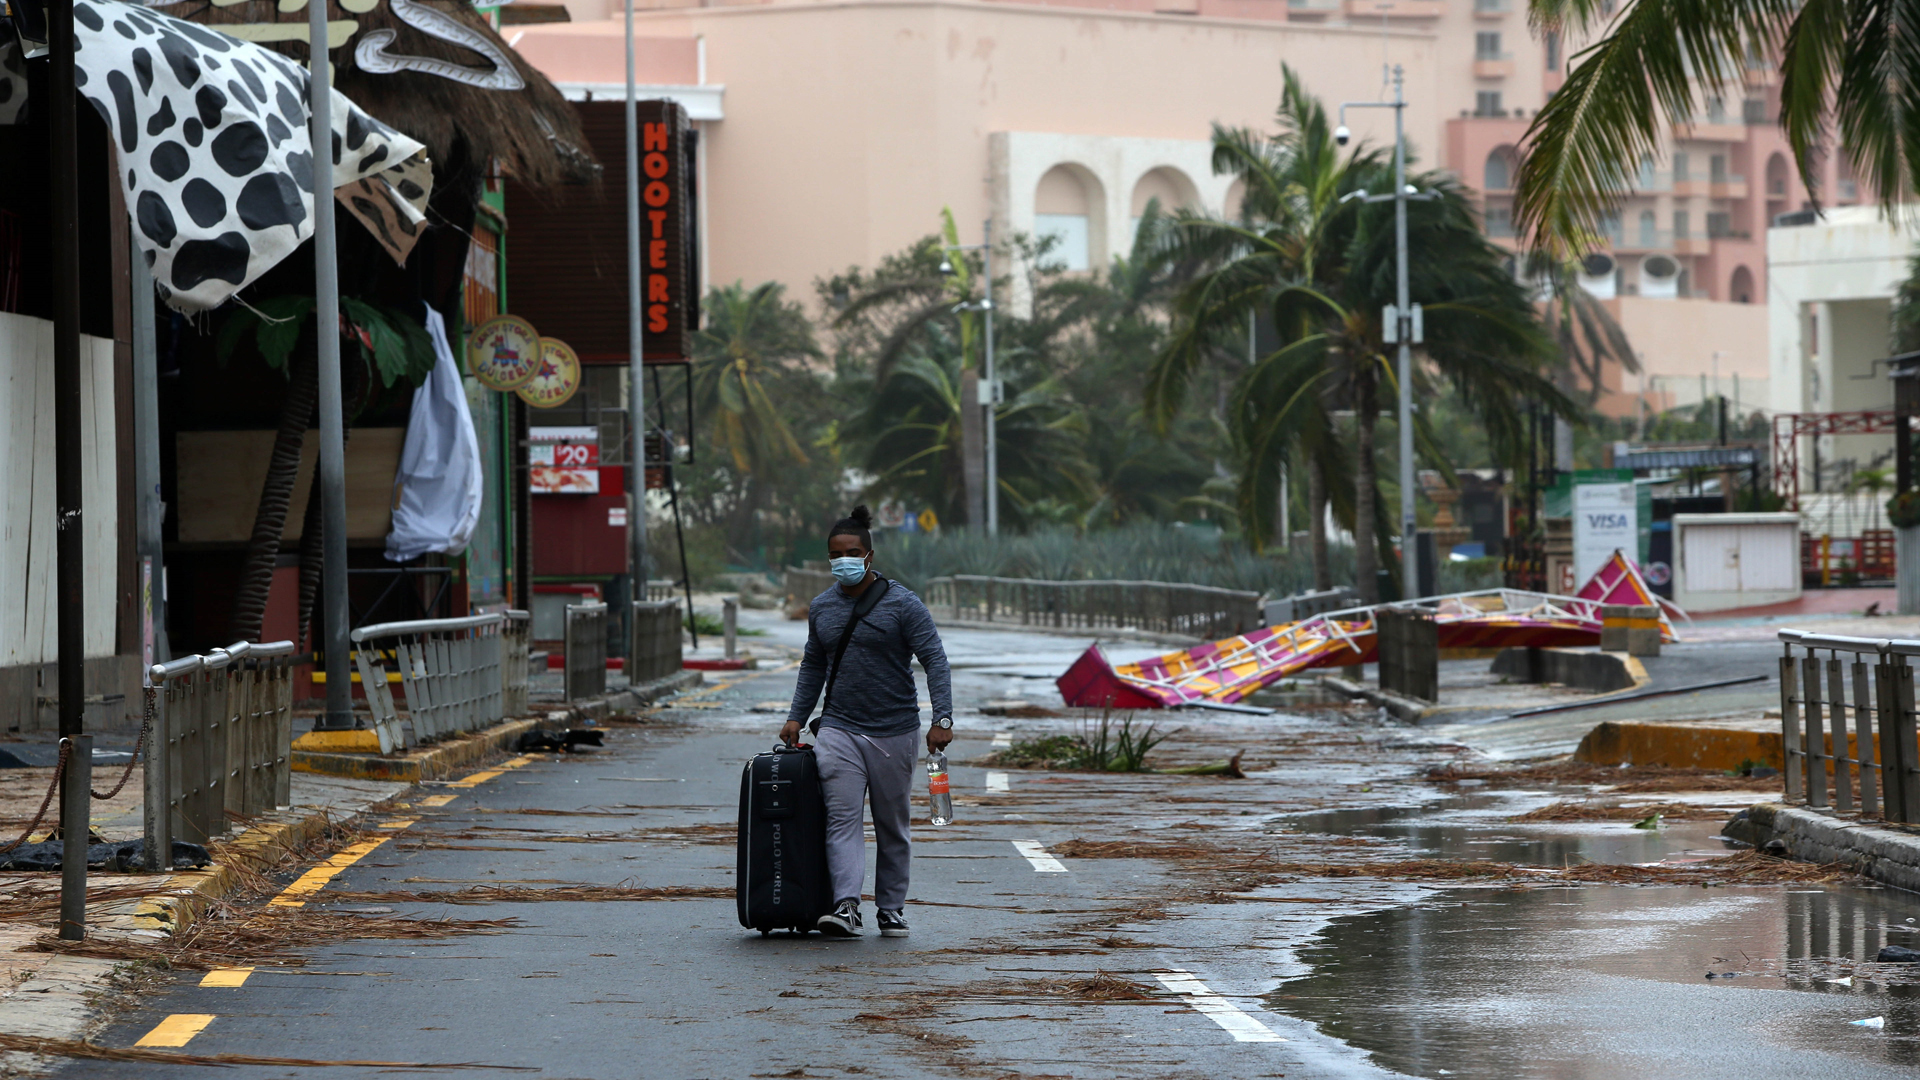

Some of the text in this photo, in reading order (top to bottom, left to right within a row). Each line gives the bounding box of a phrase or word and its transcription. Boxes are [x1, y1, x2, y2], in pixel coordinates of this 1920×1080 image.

[643, 122, 670, 333] HOOTERS
[502, 322, 532, 346] STORE
[478, 358, 534, 382] DULCERIA
[1586, 514, 1628, 528] VISA
[772, 823, 782, 905] POLO WORLD
